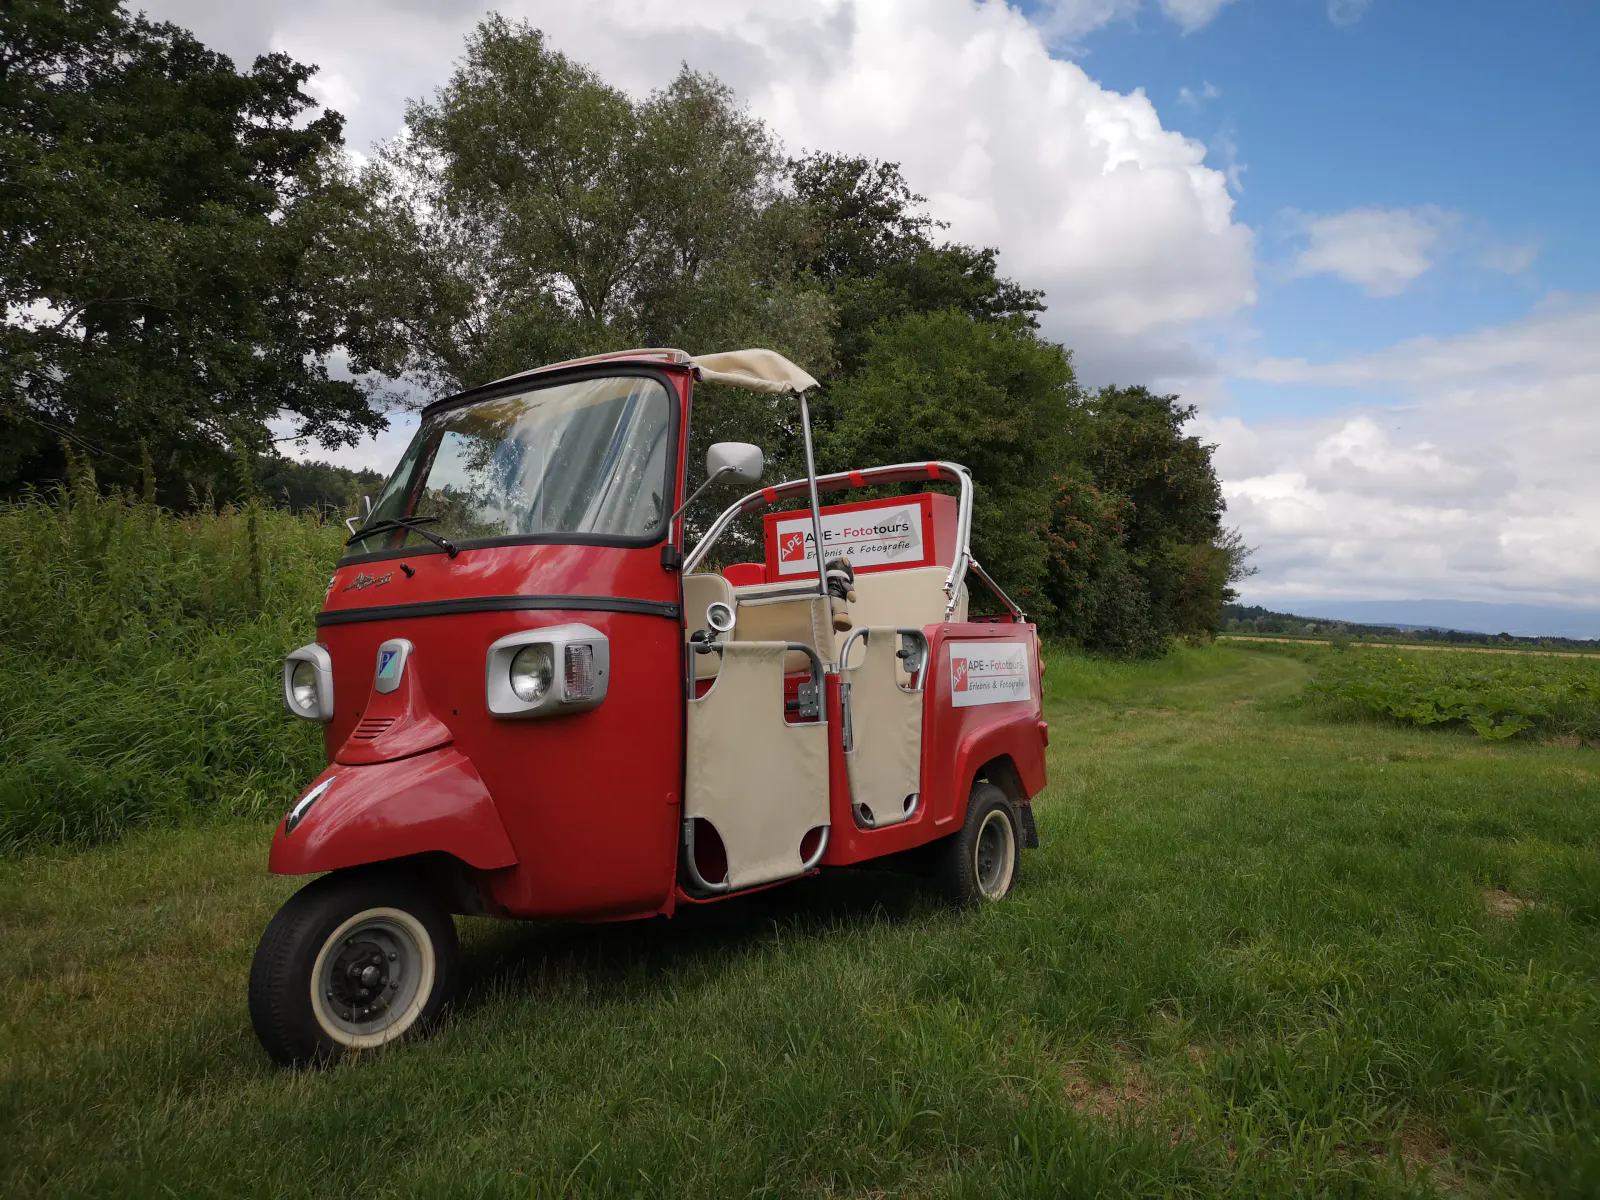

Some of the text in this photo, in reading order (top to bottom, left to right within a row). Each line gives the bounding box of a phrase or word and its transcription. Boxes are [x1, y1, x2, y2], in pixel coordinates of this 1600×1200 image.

[805, 530, 832, 543] AE
[843, 523, 909, 538] Fototours
[781, 534, 803, 560] APE
[807, 541, 910, 559] Erbnis & Fotografie
[968, 660, 984, 671] APE
[990, 660, 1024, 670] Fototours
[953, 661, 967, 690] APE
[969, 680, 1024, 690] Erlebnis & Fotografie
